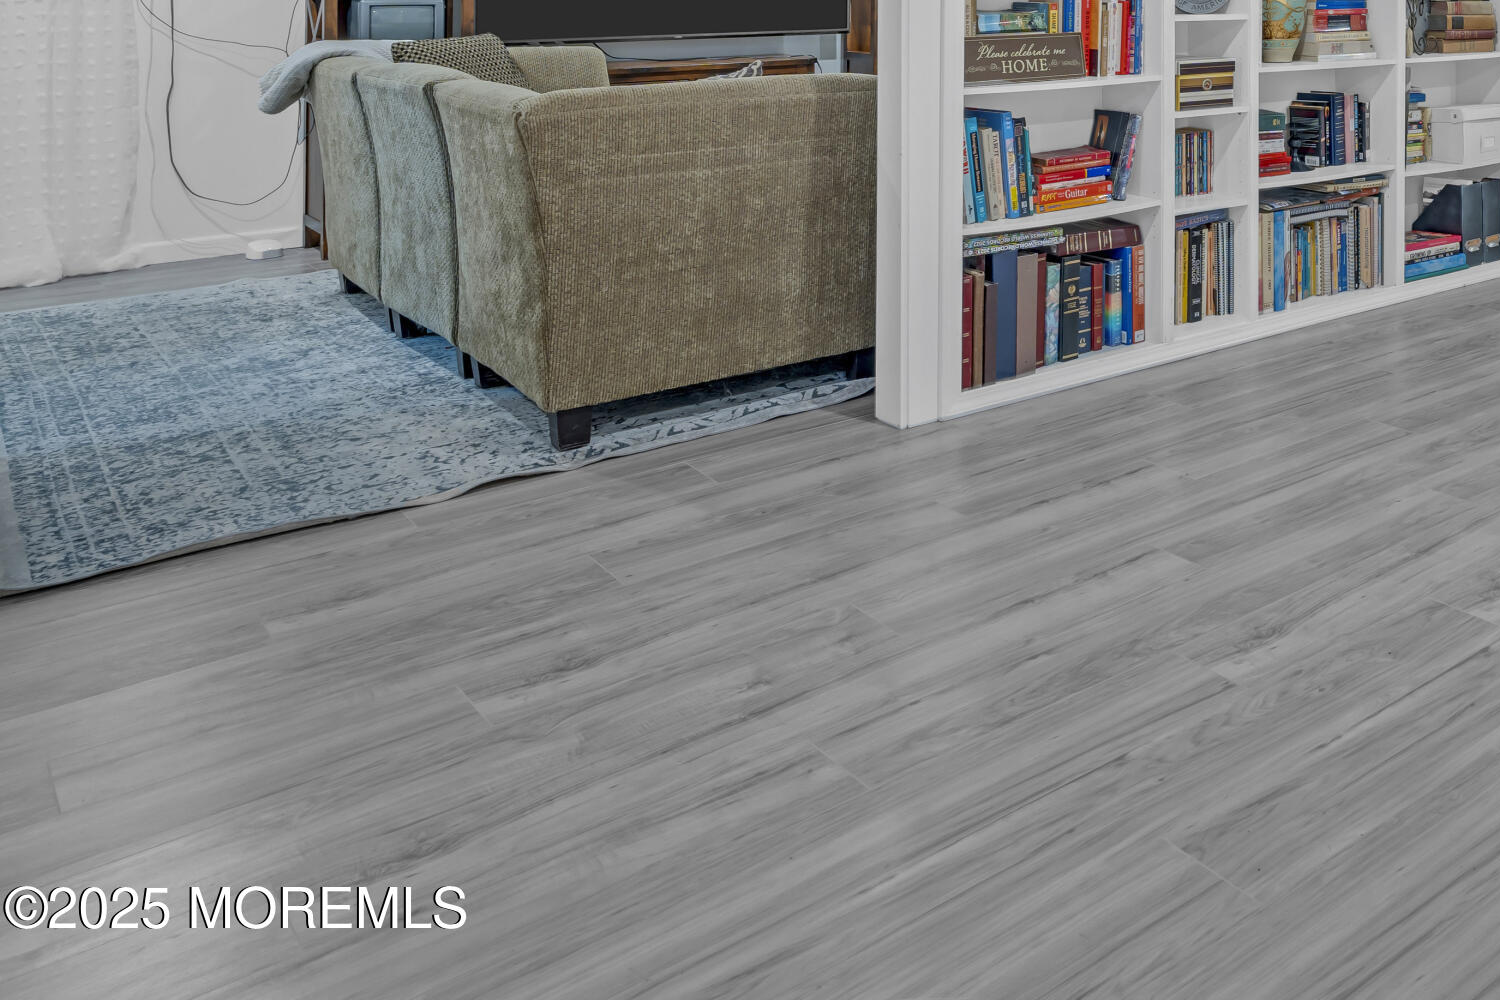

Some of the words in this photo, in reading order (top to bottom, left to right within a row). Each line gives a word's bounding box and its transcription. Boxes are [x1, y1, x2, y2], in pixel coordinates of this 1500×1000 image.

[977, 41, 1008, 61] Please
[1010, 42, 1051, 57] celebrate
[1064, 188, 1088, 199] Guitar
